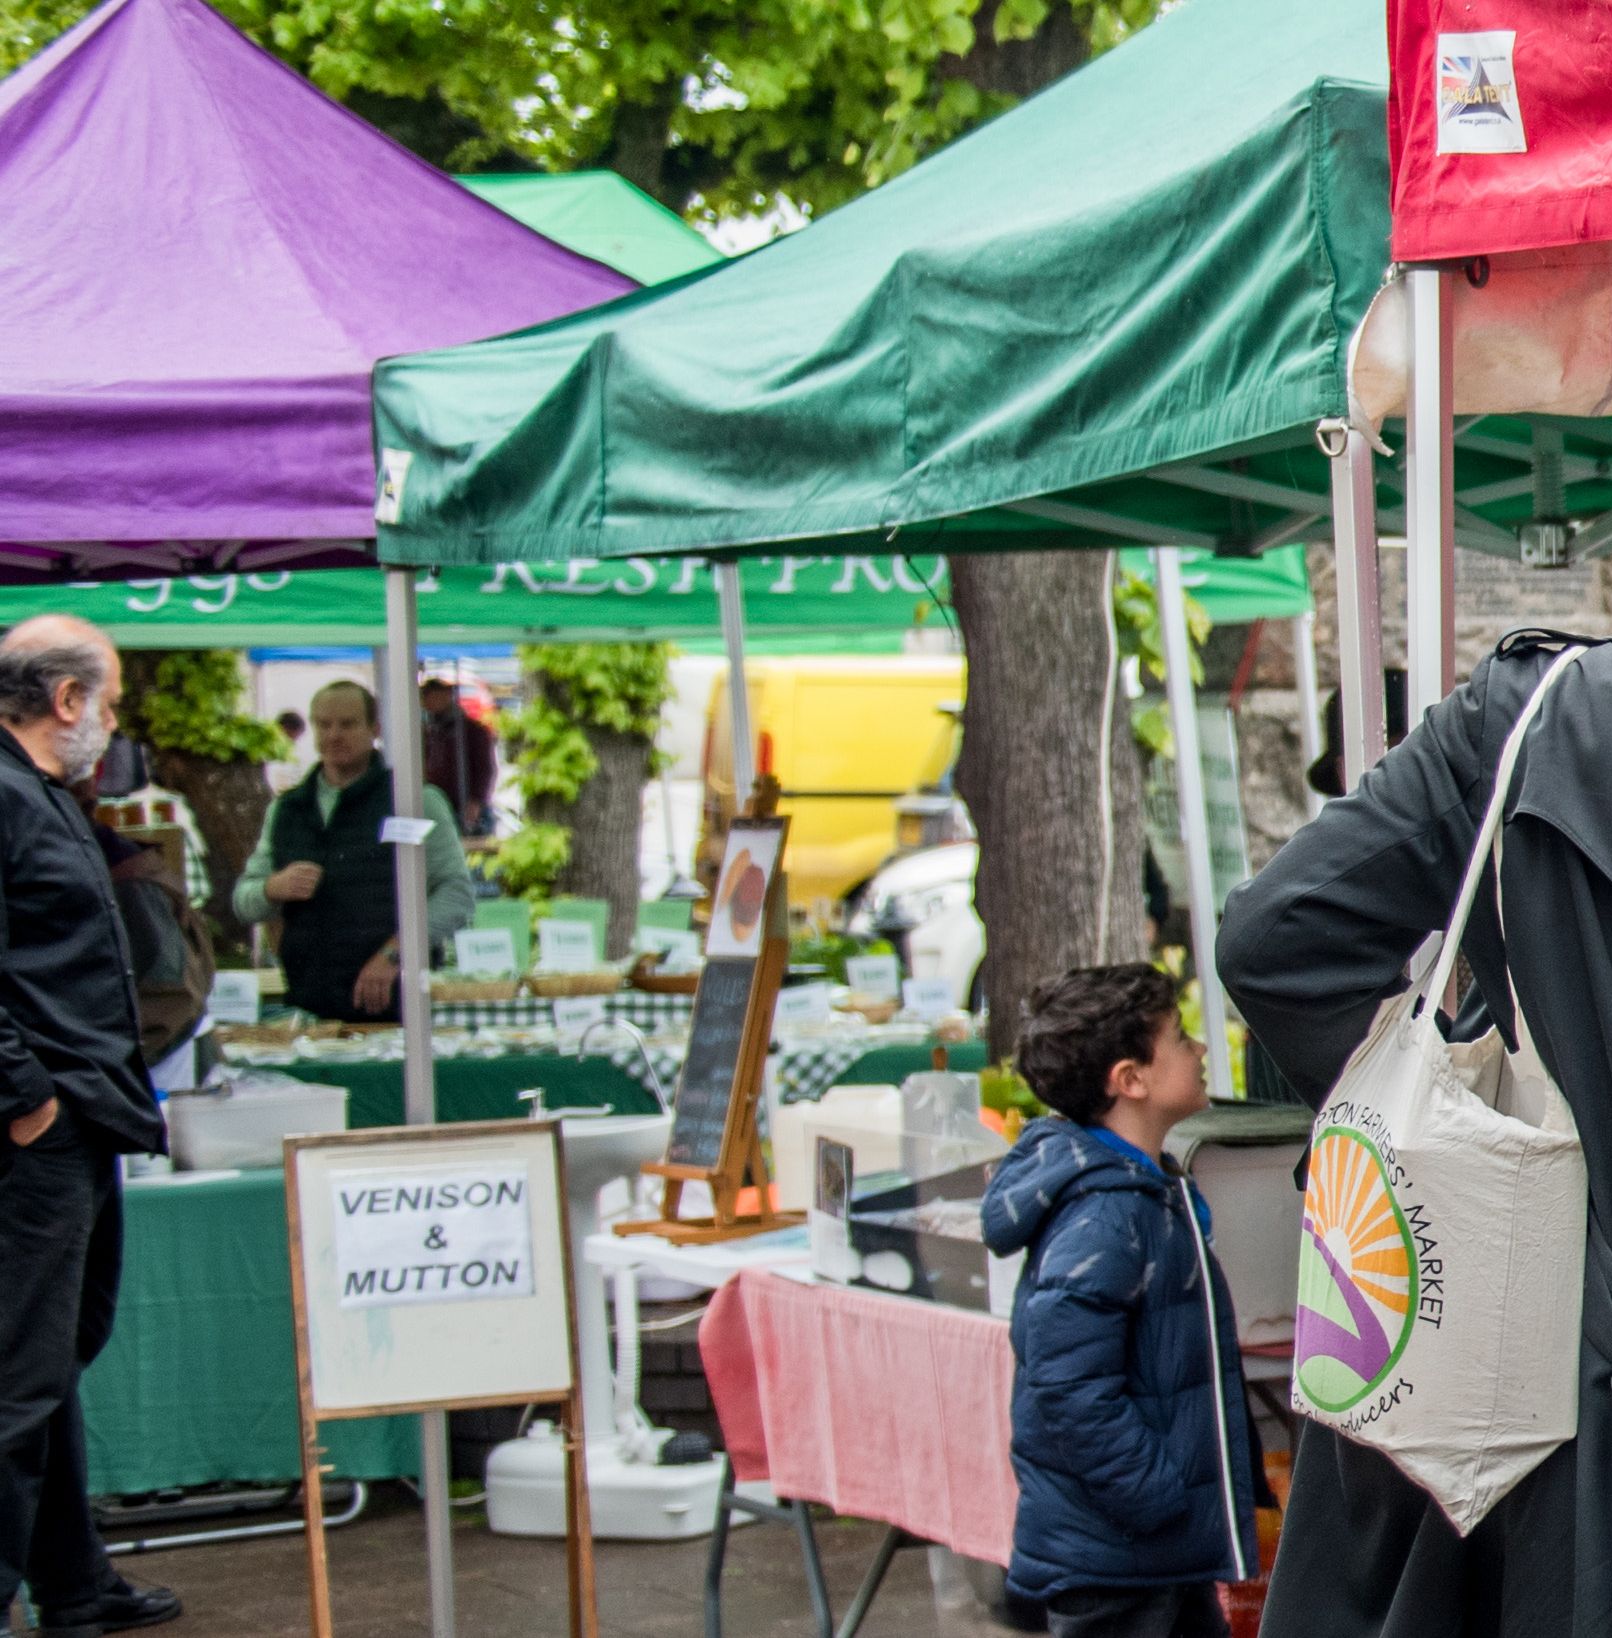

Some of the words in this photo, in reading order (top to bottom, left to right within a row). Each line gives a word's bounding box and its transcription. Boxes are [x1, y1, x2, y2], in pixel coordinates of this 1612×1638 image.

[339, 1180, 523, 1217] VENISON
[423, 1223, 448, 1251] &
[343, 1259, 519, 1297] MUTTON
[1403, 1204, 1444, 1330] MARKET
